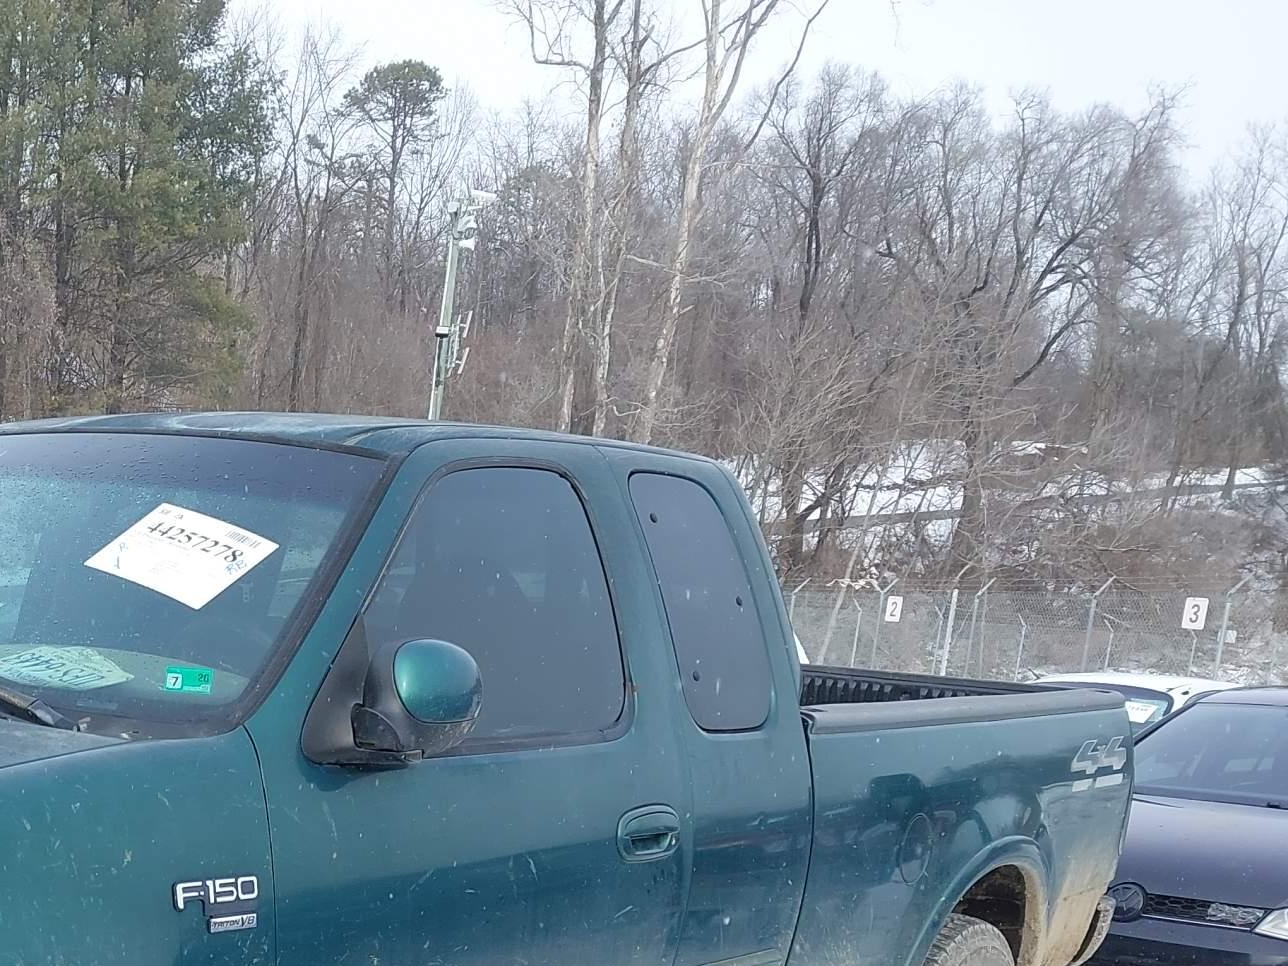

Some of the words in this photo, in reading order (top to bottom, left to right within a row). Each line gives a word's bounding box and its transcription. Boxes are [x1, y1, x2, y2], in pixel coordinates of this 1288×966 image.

[147, 521, 244, 563] 44257278
[889, 601, 898, 617] 2
[1188, 603, 1201, 624] 3
[171, 676, 179, 687] 7
[212, 919, 241, 930] TRITON
[240, 915, 256, 928] V8
